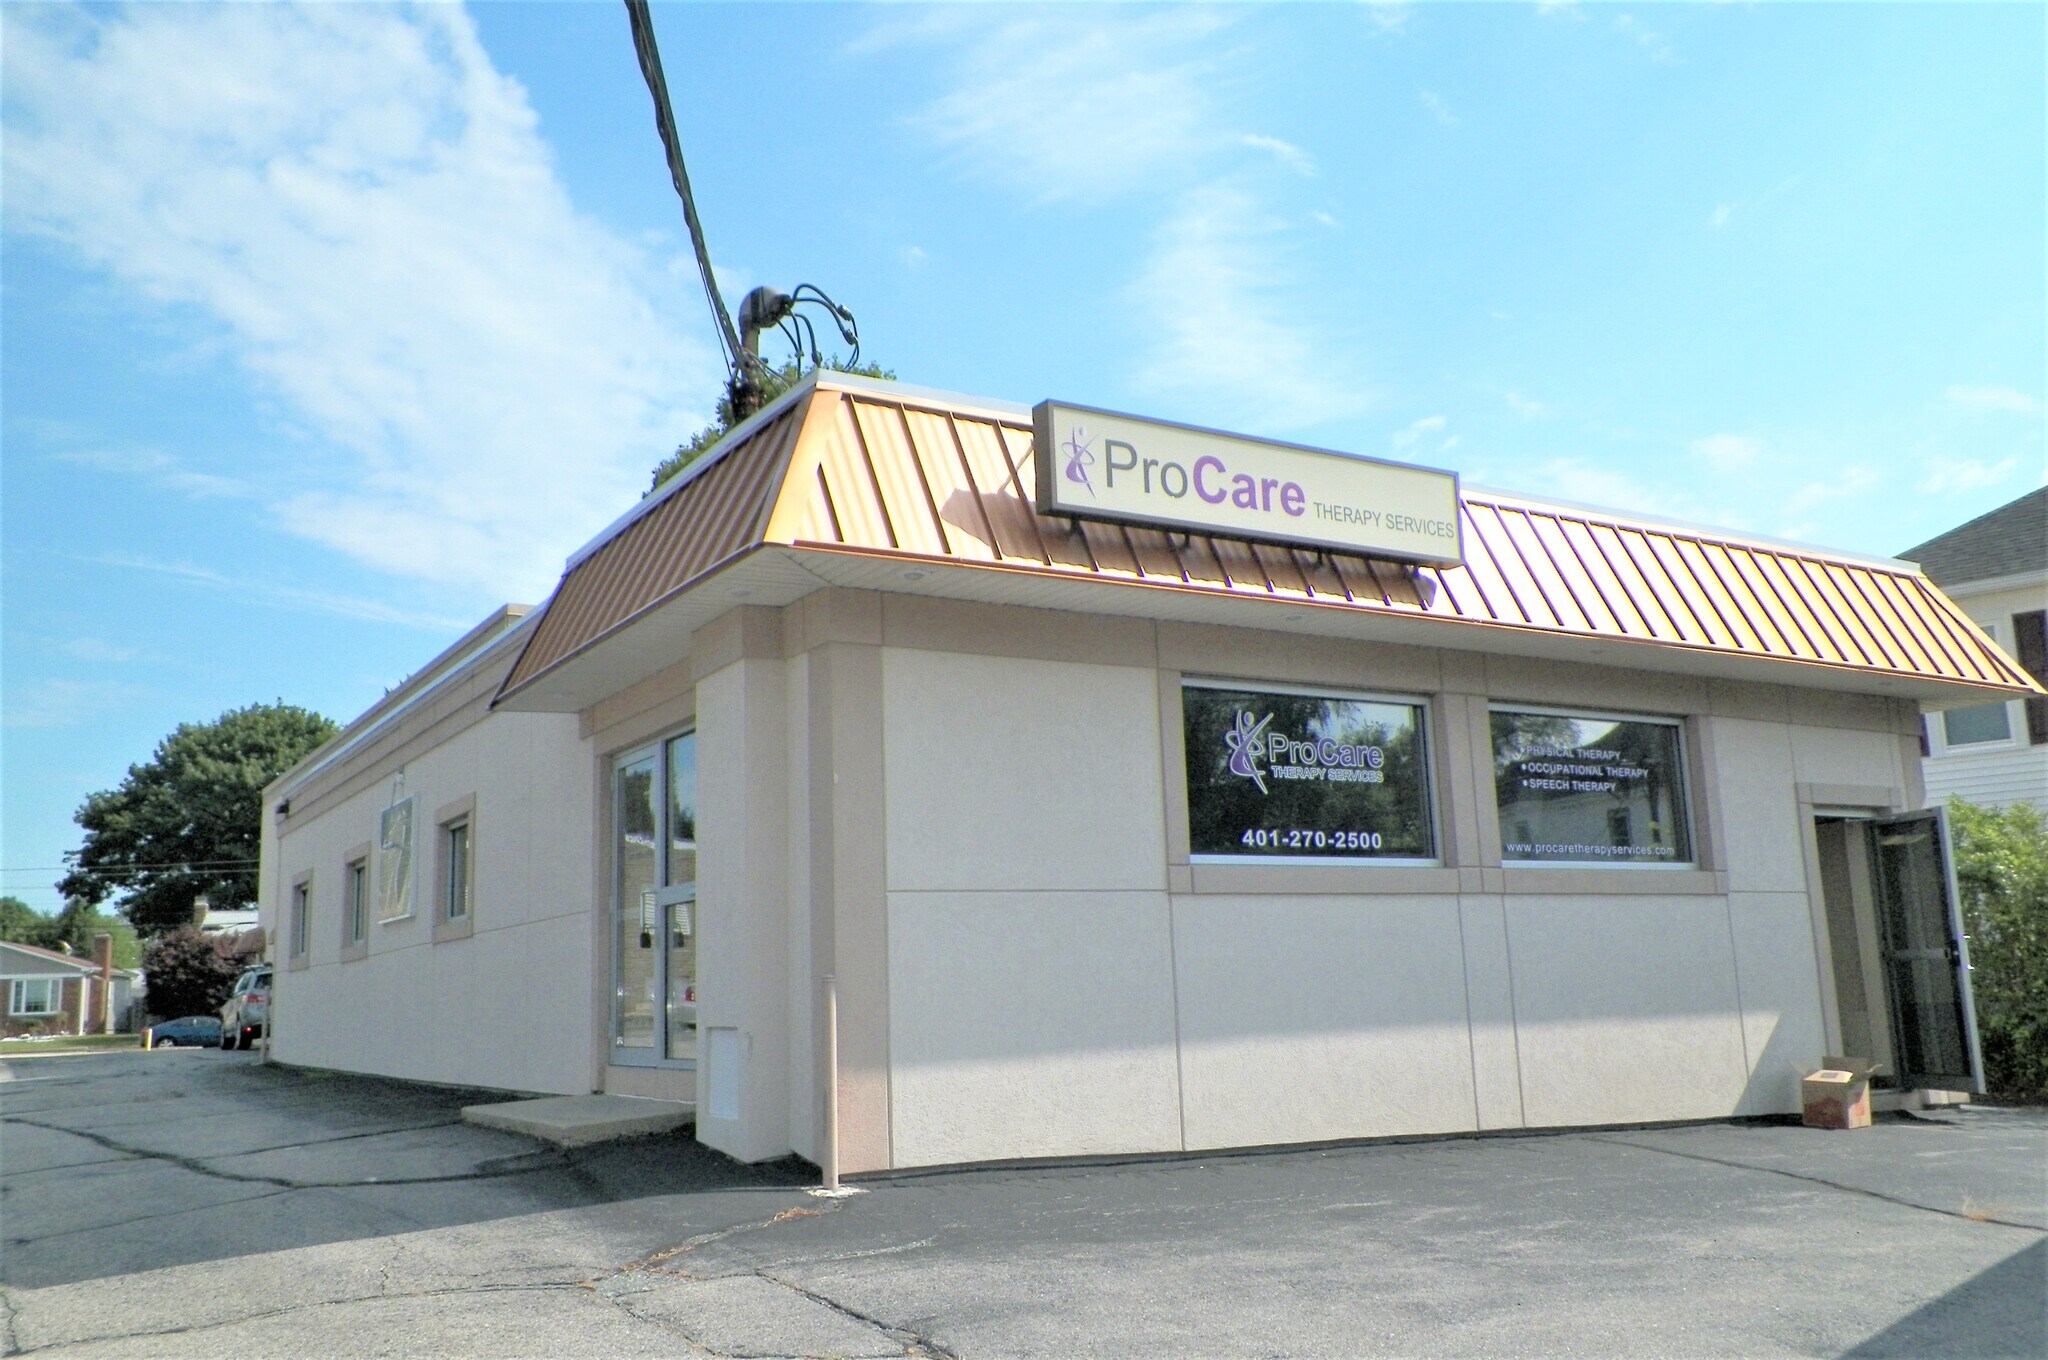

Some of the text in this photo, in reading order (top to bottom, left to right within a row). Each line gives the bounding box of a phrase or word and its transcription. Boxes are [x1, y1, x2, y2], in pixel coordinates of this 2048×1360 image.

[1105, 439, 1454, 538] ProCare THERAPY SERVICES
[1268, 733, 1384, 768] ProCare
[1526, 745, 1621, 761] PHYSICAL THERAPY
[1271, 766, 1384, 782] THERAPY SERVICES
[1528, 762, 1649, 778] OCCUPATIONAL THERAPY
[1529, 779, 1616, 793] SPEECH THERAPY
[1242, 829, 1382, 849] 401-270-2500
[1507, 843, 1675, 856] www.procaretherapyservices.com
